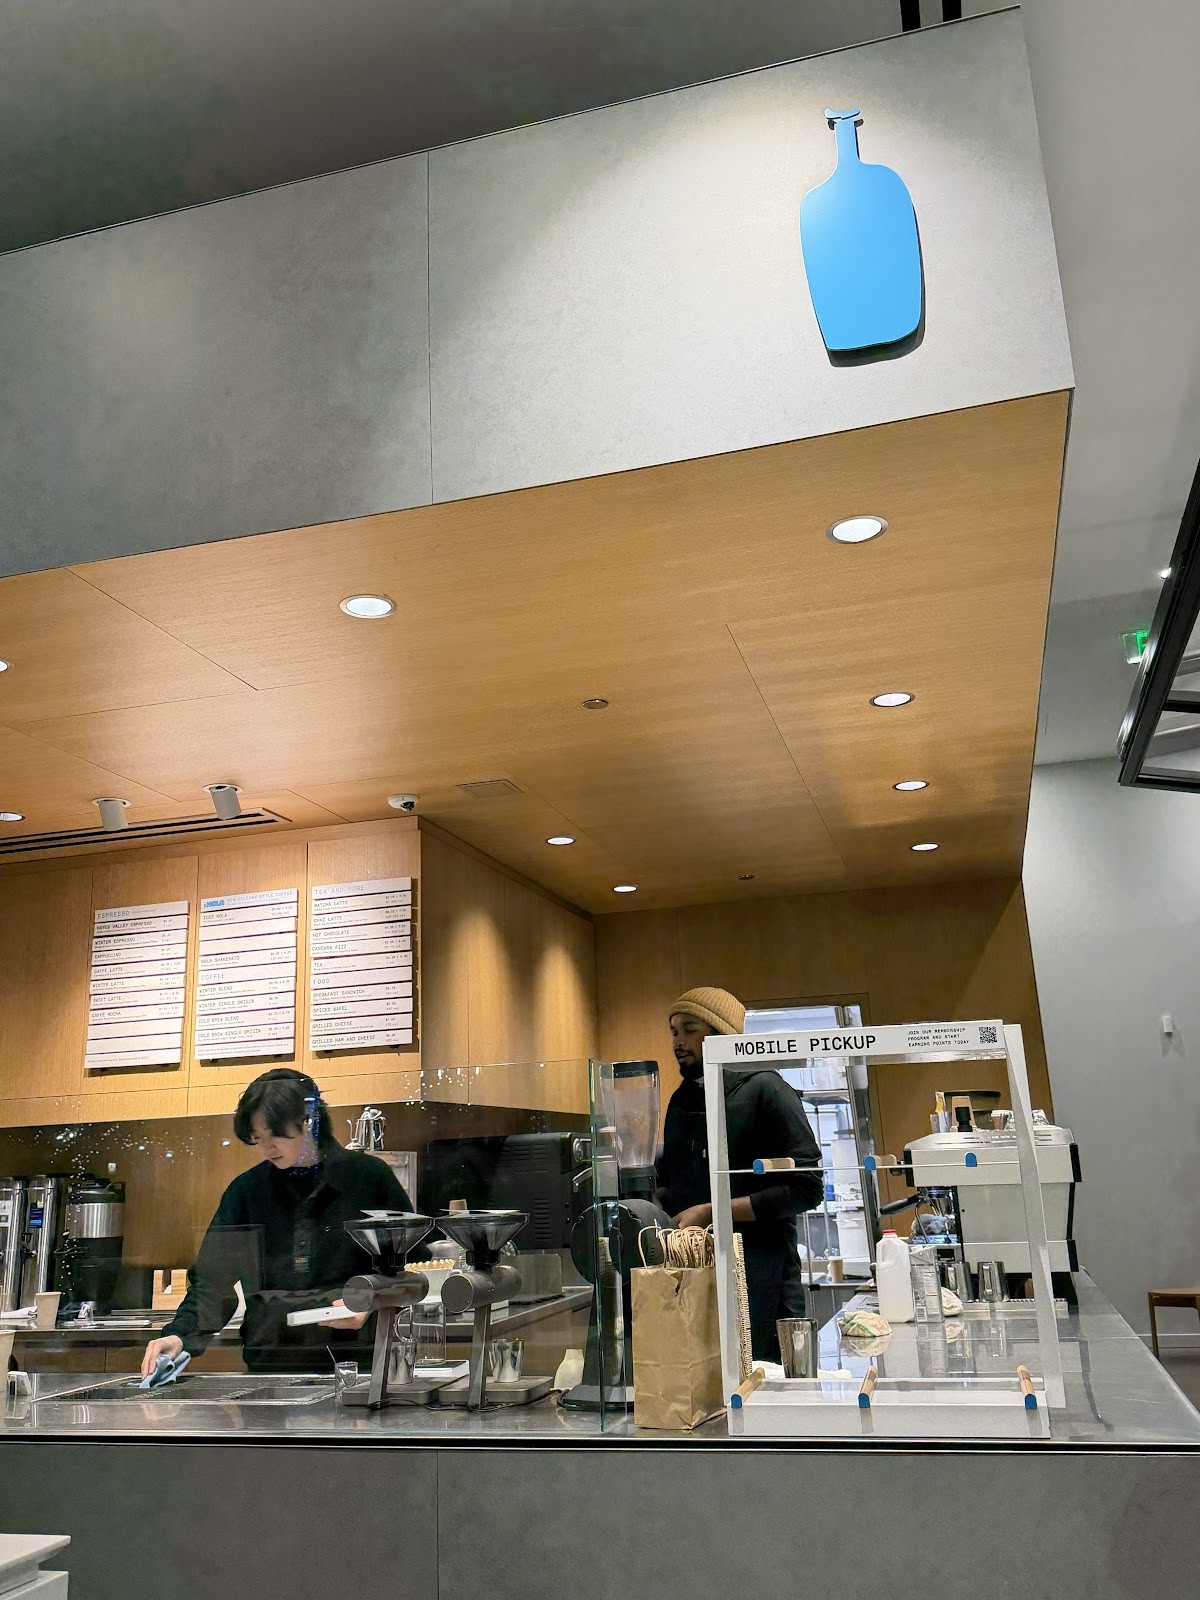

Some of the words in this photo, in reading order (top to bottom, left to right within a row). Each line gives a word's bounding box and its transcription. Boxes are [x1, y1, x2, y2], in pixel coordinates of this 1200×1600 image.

[206, 899, 225, 908] NOLA
[97, 910, 130, 920] ESPRESSO
[734, 1039, 797, 1056] MOBILE
[810, 1035, 876, 1052] PICKUP
